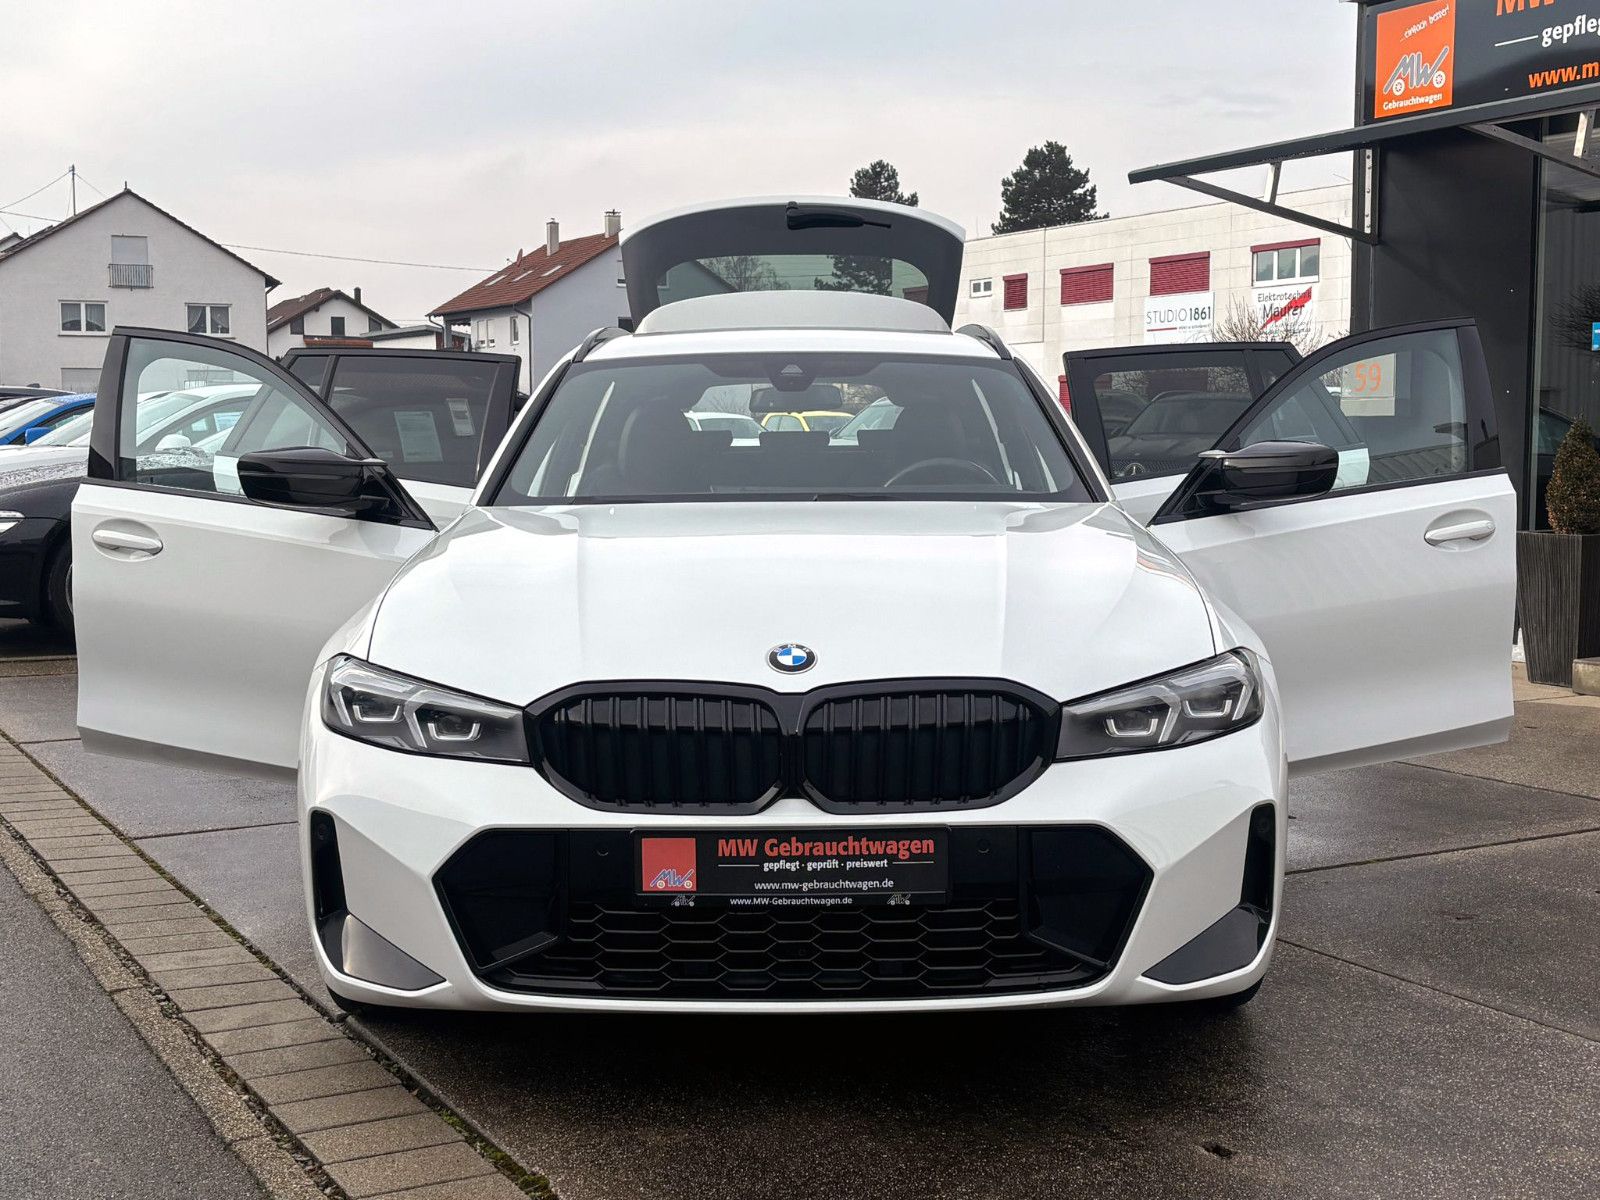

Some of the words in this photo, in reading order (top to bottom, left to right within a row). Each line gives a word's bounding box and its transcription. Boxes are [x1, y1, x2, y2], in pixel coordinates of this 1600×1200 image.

[1542, 14, 1600, 47] gepfle
[1383, 93, 1443, 110] Gebrauchtwagen
[1262, 303, 1305, 321] Maurer
[1352, 362, 1382, 393] 59
[718, 838, 758, 857] MW
[764, 836, 935, 860] Gebrauchtwagen
[763, 860, 800, 872] gepflegt
[806, 859, 839, 871] geprüft
[846, 859, 888, 870] preiswert
[754, 878, 894, 891] www.mw-gebrauchtwagen.de
[730, 896, 853, 907] www.MW-Gebrauchtwagen.de
